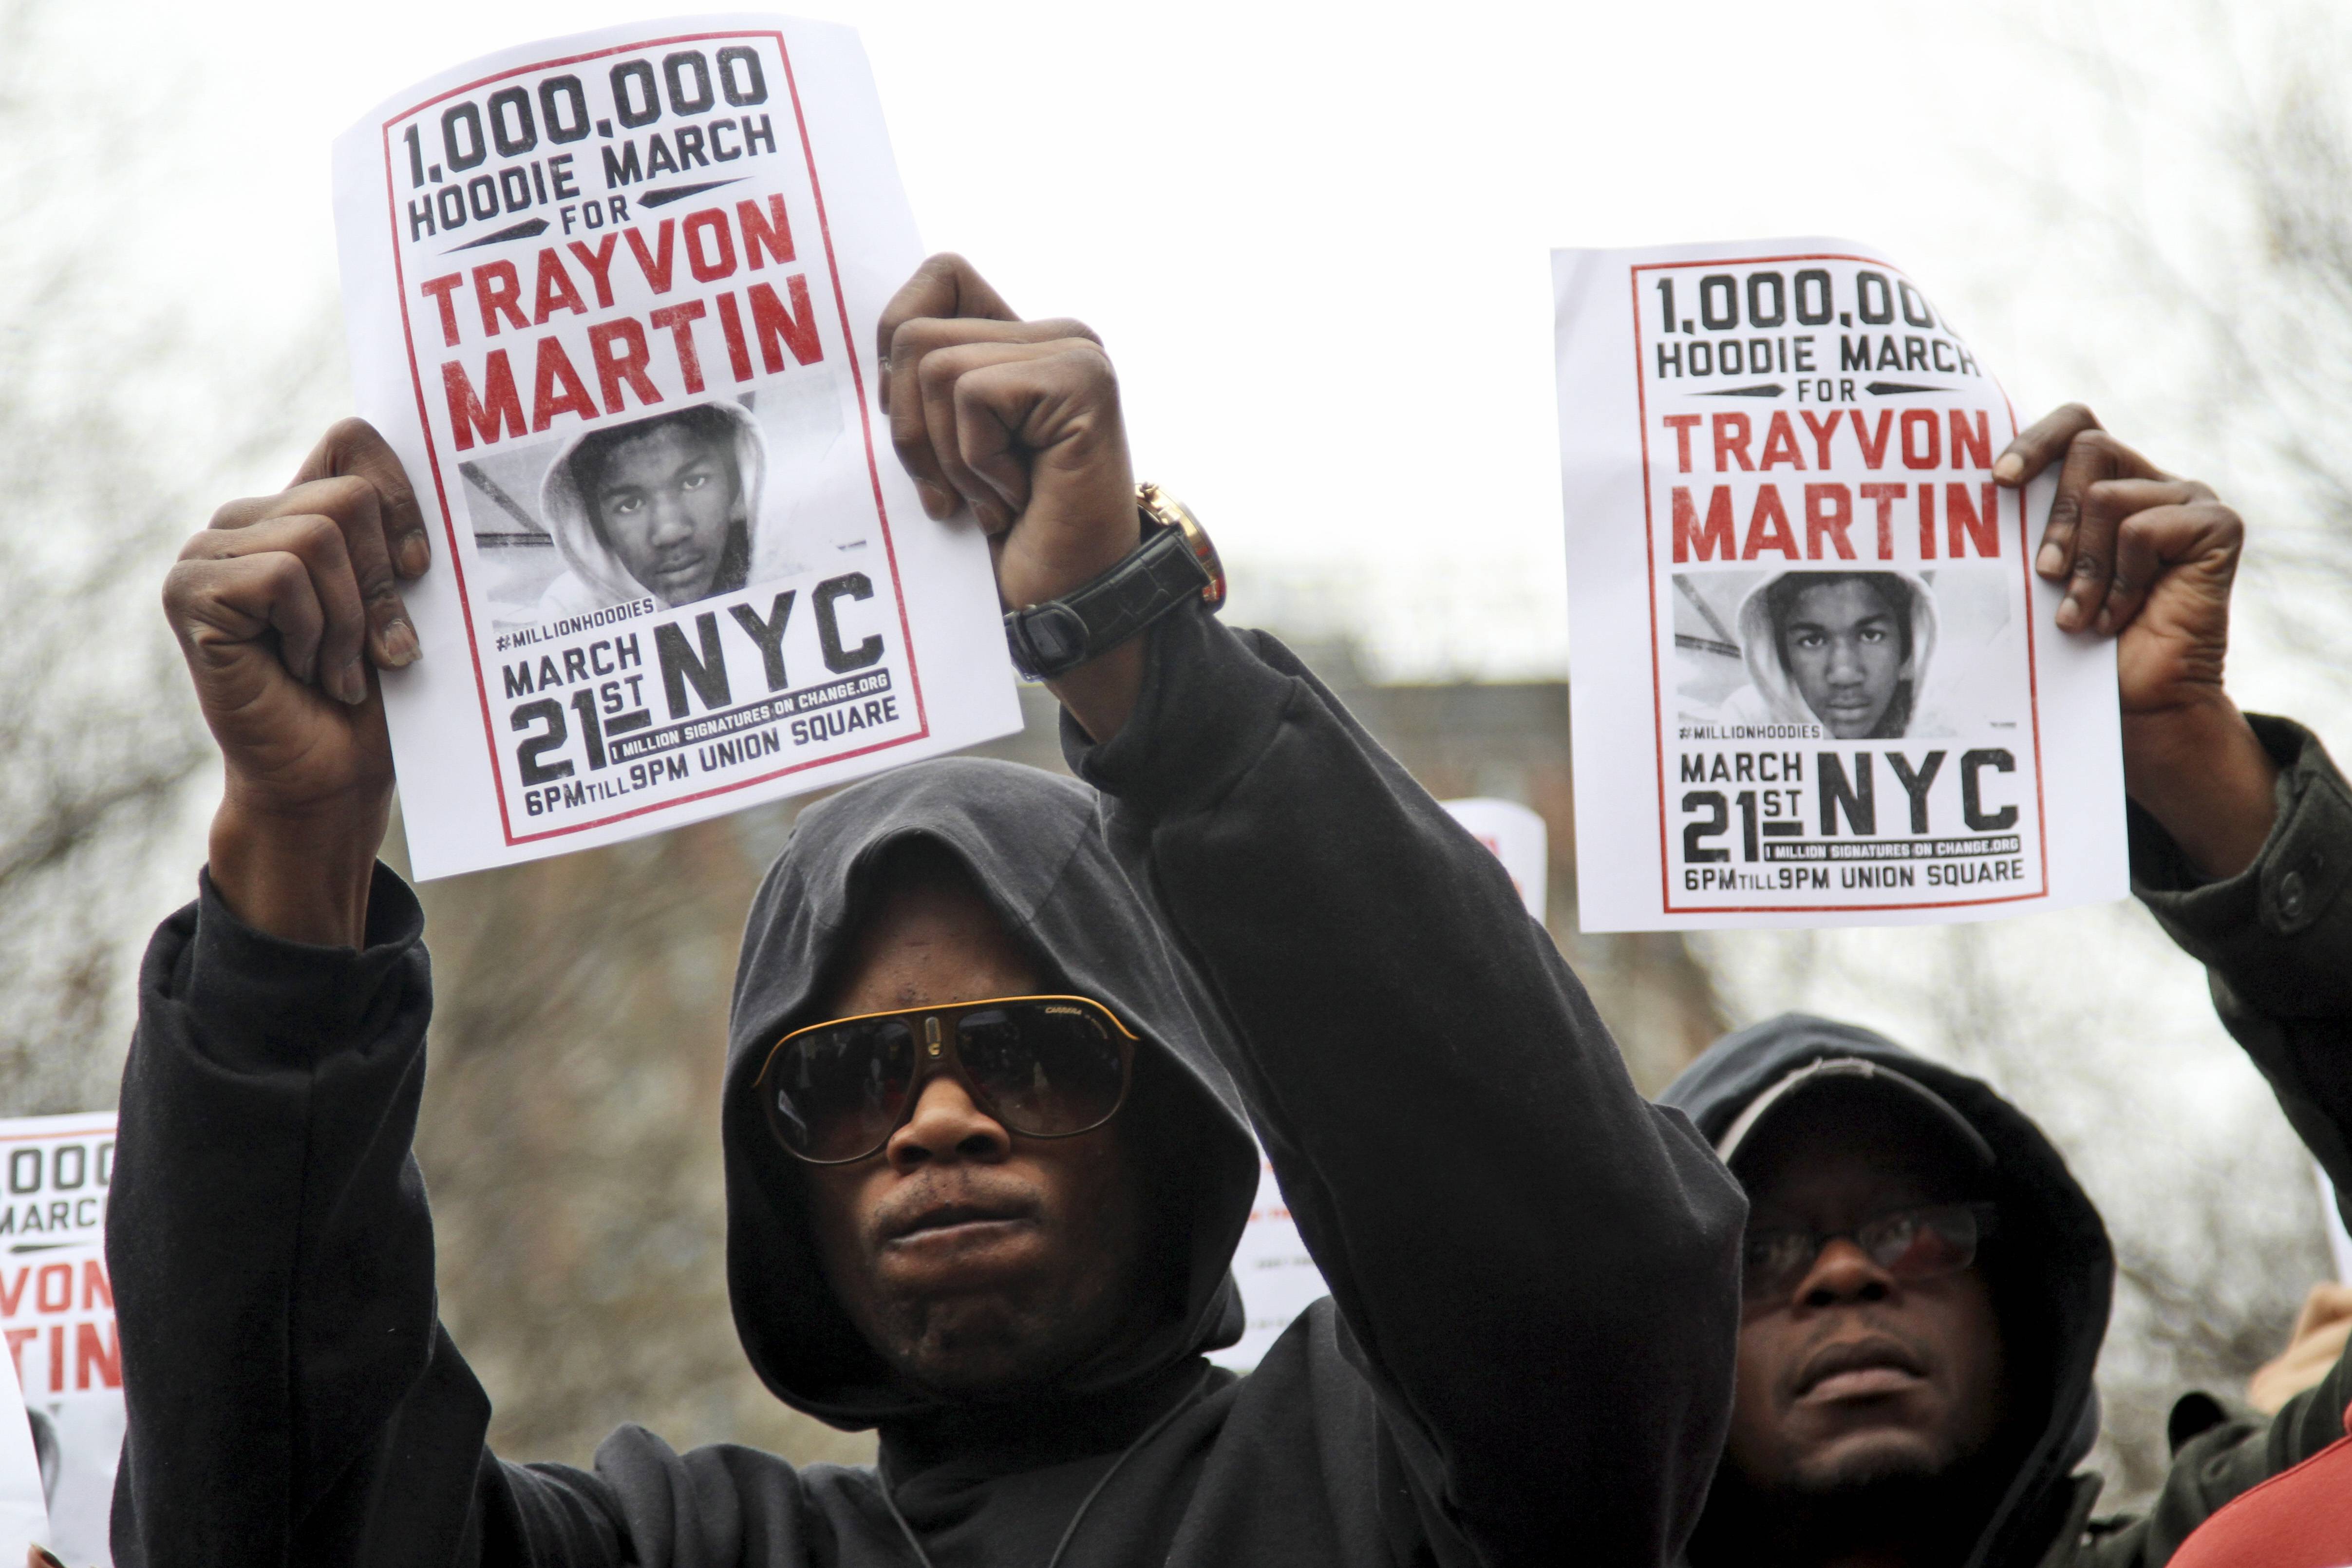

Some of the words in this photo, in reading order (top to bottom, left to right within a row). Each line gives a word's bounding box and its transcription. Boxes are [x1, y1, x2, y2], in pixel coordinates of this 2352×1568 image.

[408, 154, 580, 241] HOODIE
[601, 113, 777, 189] MARCH
[560, 194, 631, 234] FOR
[420, 193, 797, 347] TRAYVON
[1656, 268, 1963, 340] 1,000,00
[440, 273, 825, 452] MARTIN
[1656, 335, 1817, 378] HOODIE
[1841, 334, 1982, 378] MARCH
[1797, 379, 1857, 402] FOR
[1663, 408, 1993, 473] TRAYVON
[1672, 482, 2001, 564] MARTIN
[495, 598, 655, 652] #MILLIONHOODIES
[653, 571, 884, 719] NYC
[502, 632, 641, 699] MARCH
[611, 747, 618, 760] 1
[622, 730, 679, 757] MILLION
[684, 705, 770, 741] SIGNATURES
[774, 699, 794, 715] ON
[798, 674, 888, 708] CHANGE.ORG
[699, 727, 780, 772] UNION
[791, 696, 900, 746] SQUARE
[1679, 725, 1821, 739] #MILLIONHOODIES
[1681, 752, 1804, 783] MARCH
[1817, 748, 2019, 836] NYC
[1765, 846, 1771, 859] 1
[1775, 844, 1826, 859] MILLION
[1832, 842, 1910, 859] SIGNATURES
[1915, 841, 1933, 856] ON
[1937, 836, 2019, 855] CHANGE.ORG
[1842, 866, 1915, 889] UNION
[1927, 858, 2025, 887] SQUARE
[0, 1197, 108, 1234] MARC
